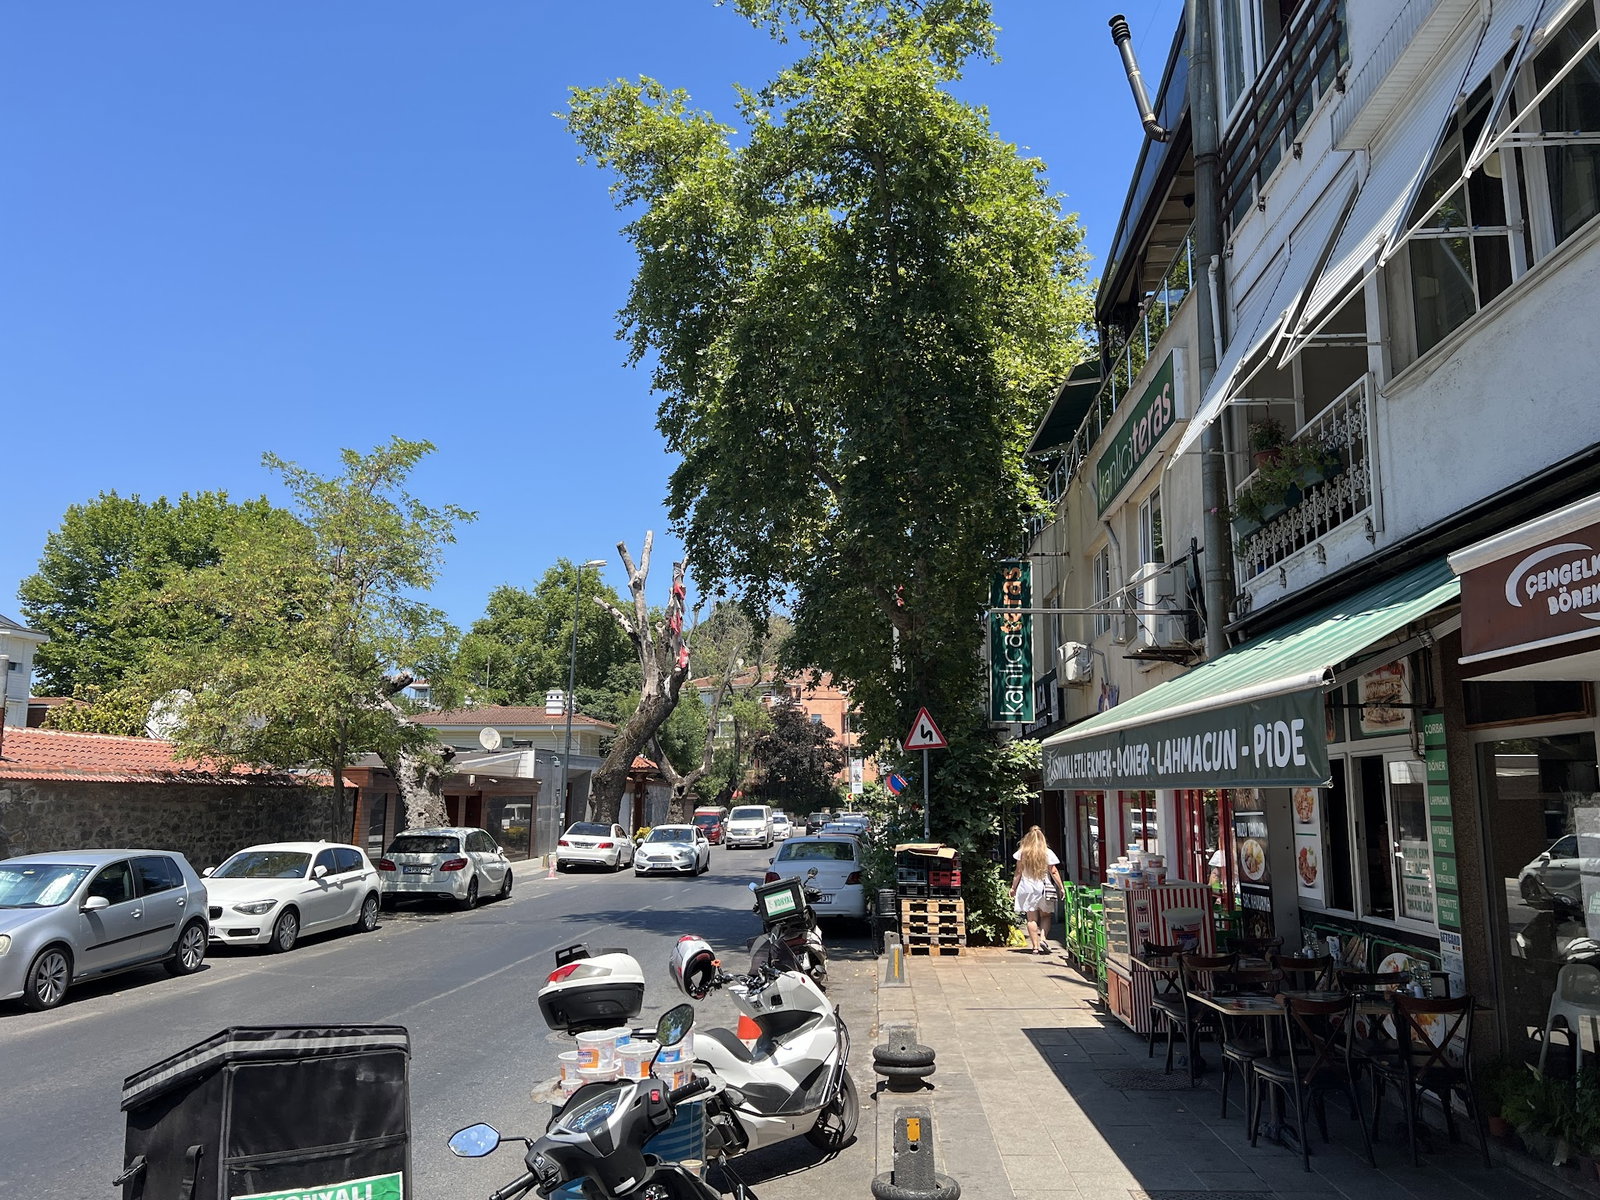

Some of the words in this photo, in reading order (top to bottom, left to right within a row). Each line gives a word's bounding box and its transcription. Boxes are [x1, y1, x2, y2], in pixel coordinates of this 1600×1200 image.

[1424, 723, 1444, 736] ÇORBA
[1157, 728, 1237, 775] LAHMACUN
[1254, 718, 1306, 768] PİDE
[1427, 760, 1446, 771] DÖNER
